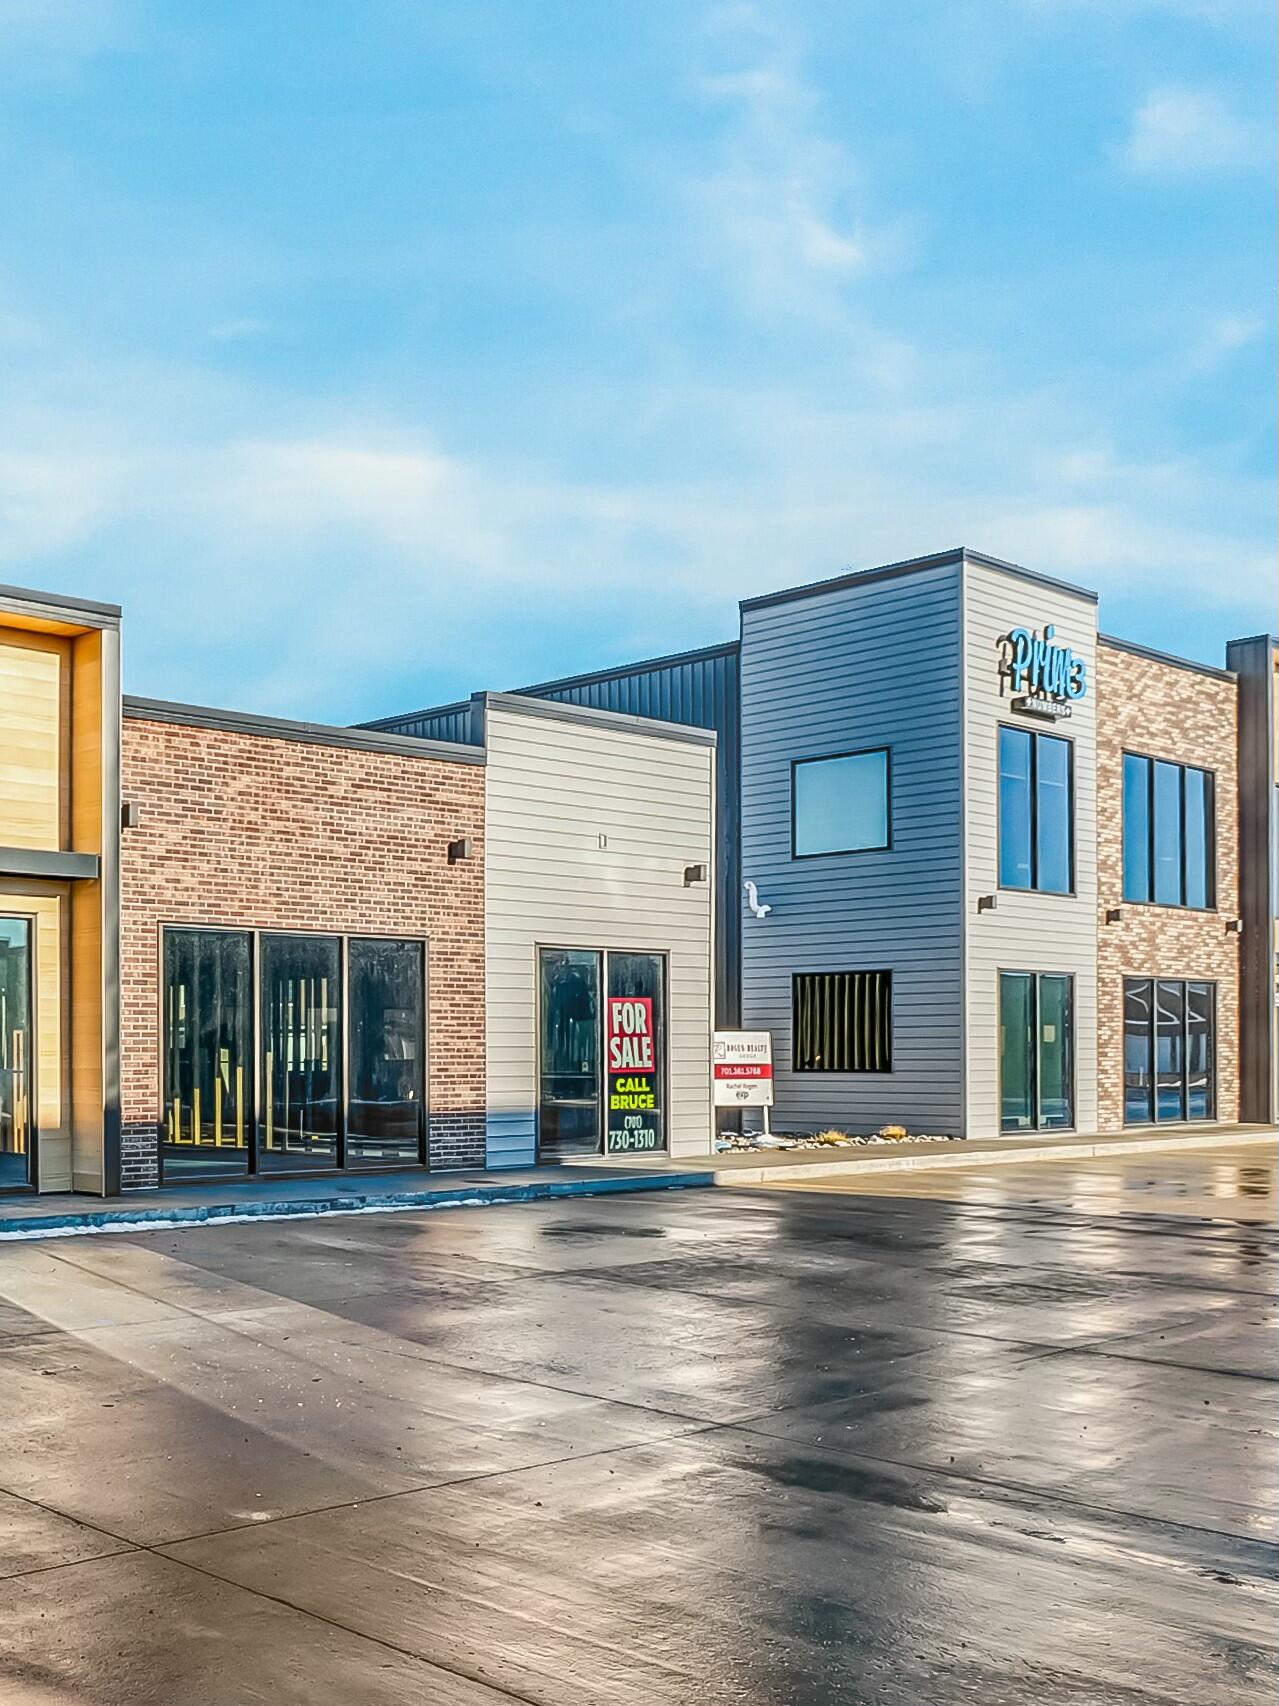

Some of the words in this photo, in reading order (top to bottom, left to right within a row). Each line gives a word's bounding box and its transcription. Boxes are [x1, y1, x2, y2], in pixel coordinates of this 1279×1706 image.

[612, 1002, 647, 1035] FOR
[610, 1036, 653, 1068] SALE
[616, 1077, 650, 1092] CALL
[610, 1094, 654, 1110] BRUCE
[609, 1129, 655, 1150] 730-1310
